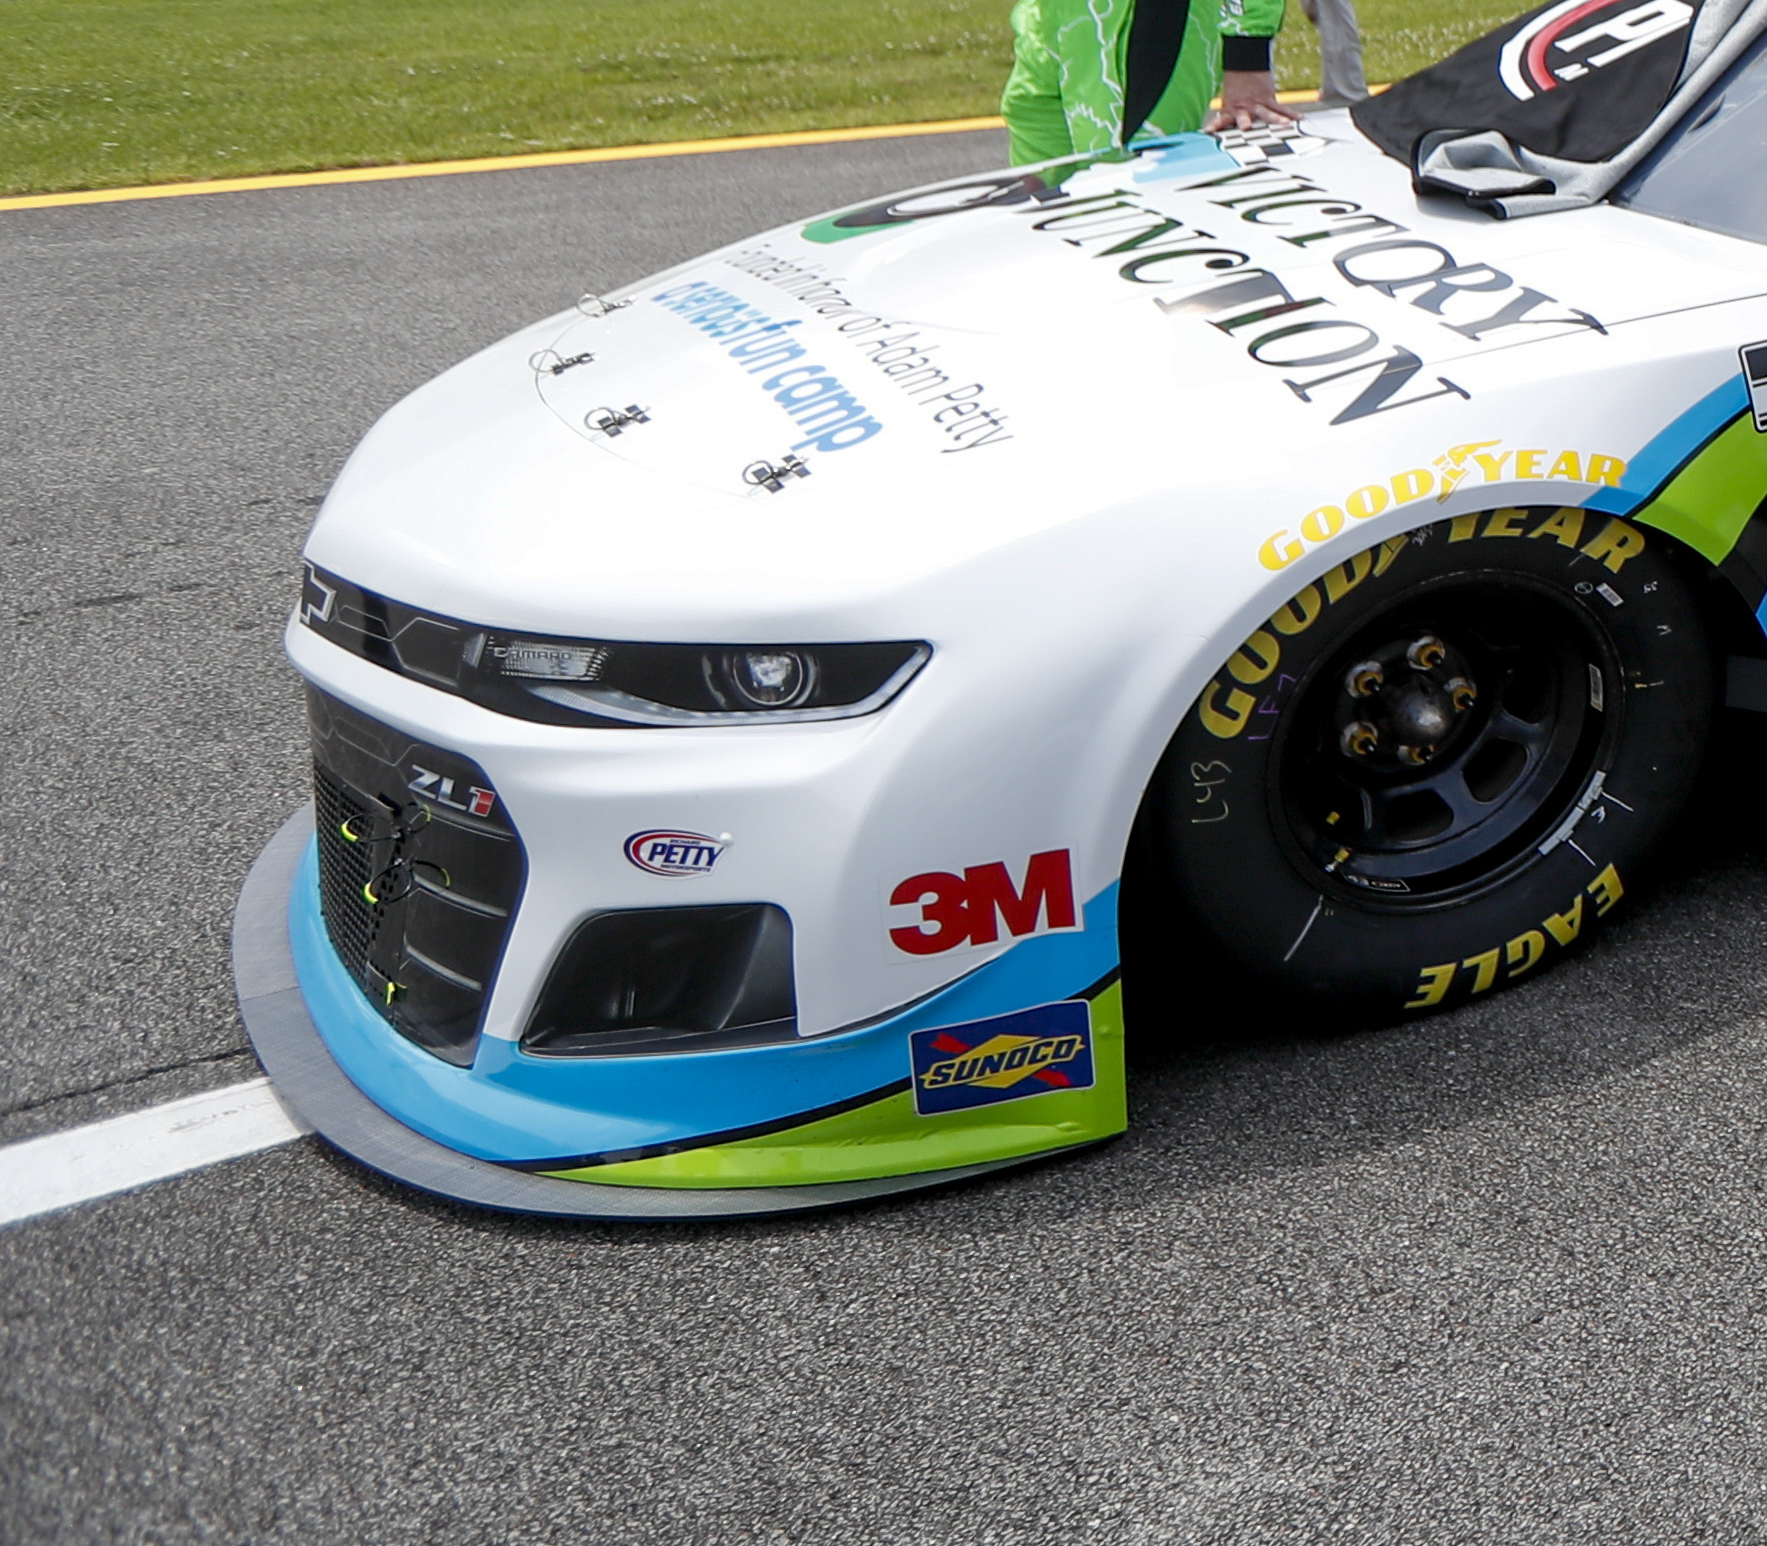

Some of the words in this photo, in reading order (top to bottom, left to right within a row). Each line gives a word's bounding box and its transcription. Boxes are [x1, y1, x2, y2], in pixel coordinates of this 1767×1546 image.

[1012, 187, 1472, 427] JUNCTION
[1178, 164, 1610, 344] VICTORY
[761, 364, 884, 453] camp
[854, 330, 951, 396] Adam
[916, 382, 1014, 454] Petty
[1258, 447, 1628, 573] GOODYEAR
[407, 763, 496, 818] ZL1
[647, 842, 726, 867] PETTY
[888, 847, 1077, 956] 3M
[1403, 862, 1625, 1010] EAGLE
[931, 1037, 1080, 1085] SUNOCO
